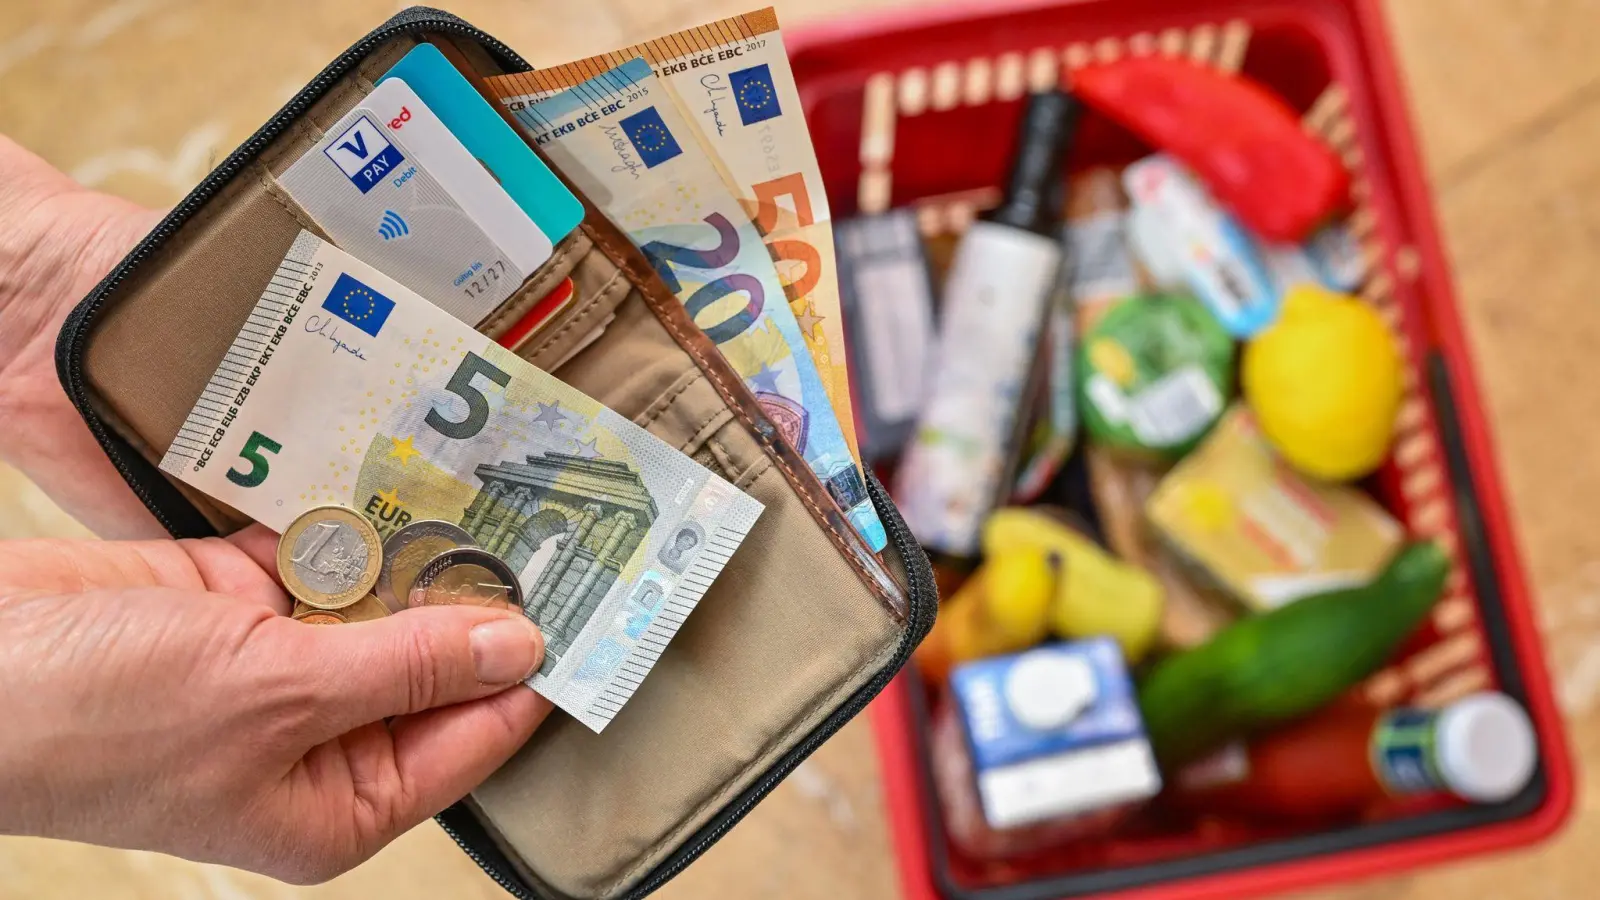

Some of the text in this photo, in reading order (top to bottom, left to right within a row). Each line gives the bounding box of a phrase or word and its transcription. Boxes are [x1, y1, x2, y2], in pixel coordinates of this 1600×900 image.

[662, 62, 688, 77] EKB
[718, 46, 743, 61] EBC
[746, 39, 766, 52] 2017
[535, 132, 552, 146] KT
[552, 122, 576, 138] EKB
[601, 99, 626, 116] EBC
[626, 86, 649, 103] 2015
[336, 130, 369, 160] V
[363, 154, 390, 183] PAY
[392, 166, 418, 188] Debit
[737, 171, 822, 303] 50
[464, 260, 505, 299] 12/27
[640, 211, 765, 345] 20
[208, 427, 226, 448] ECB
[233, 386, 251, 407] EZB
[245, 365, 262, 387] EKP
[257, 344, 275, 366] EKT
[270, 324, 288, 346] EKB
[295, 282, 313, 304] EBC
[308, 261, 324, 281] 2013
[424, 350, 512, 440] 5
[225, 430, 283, 488] 5
[364, 494, 412, 527] EUR
